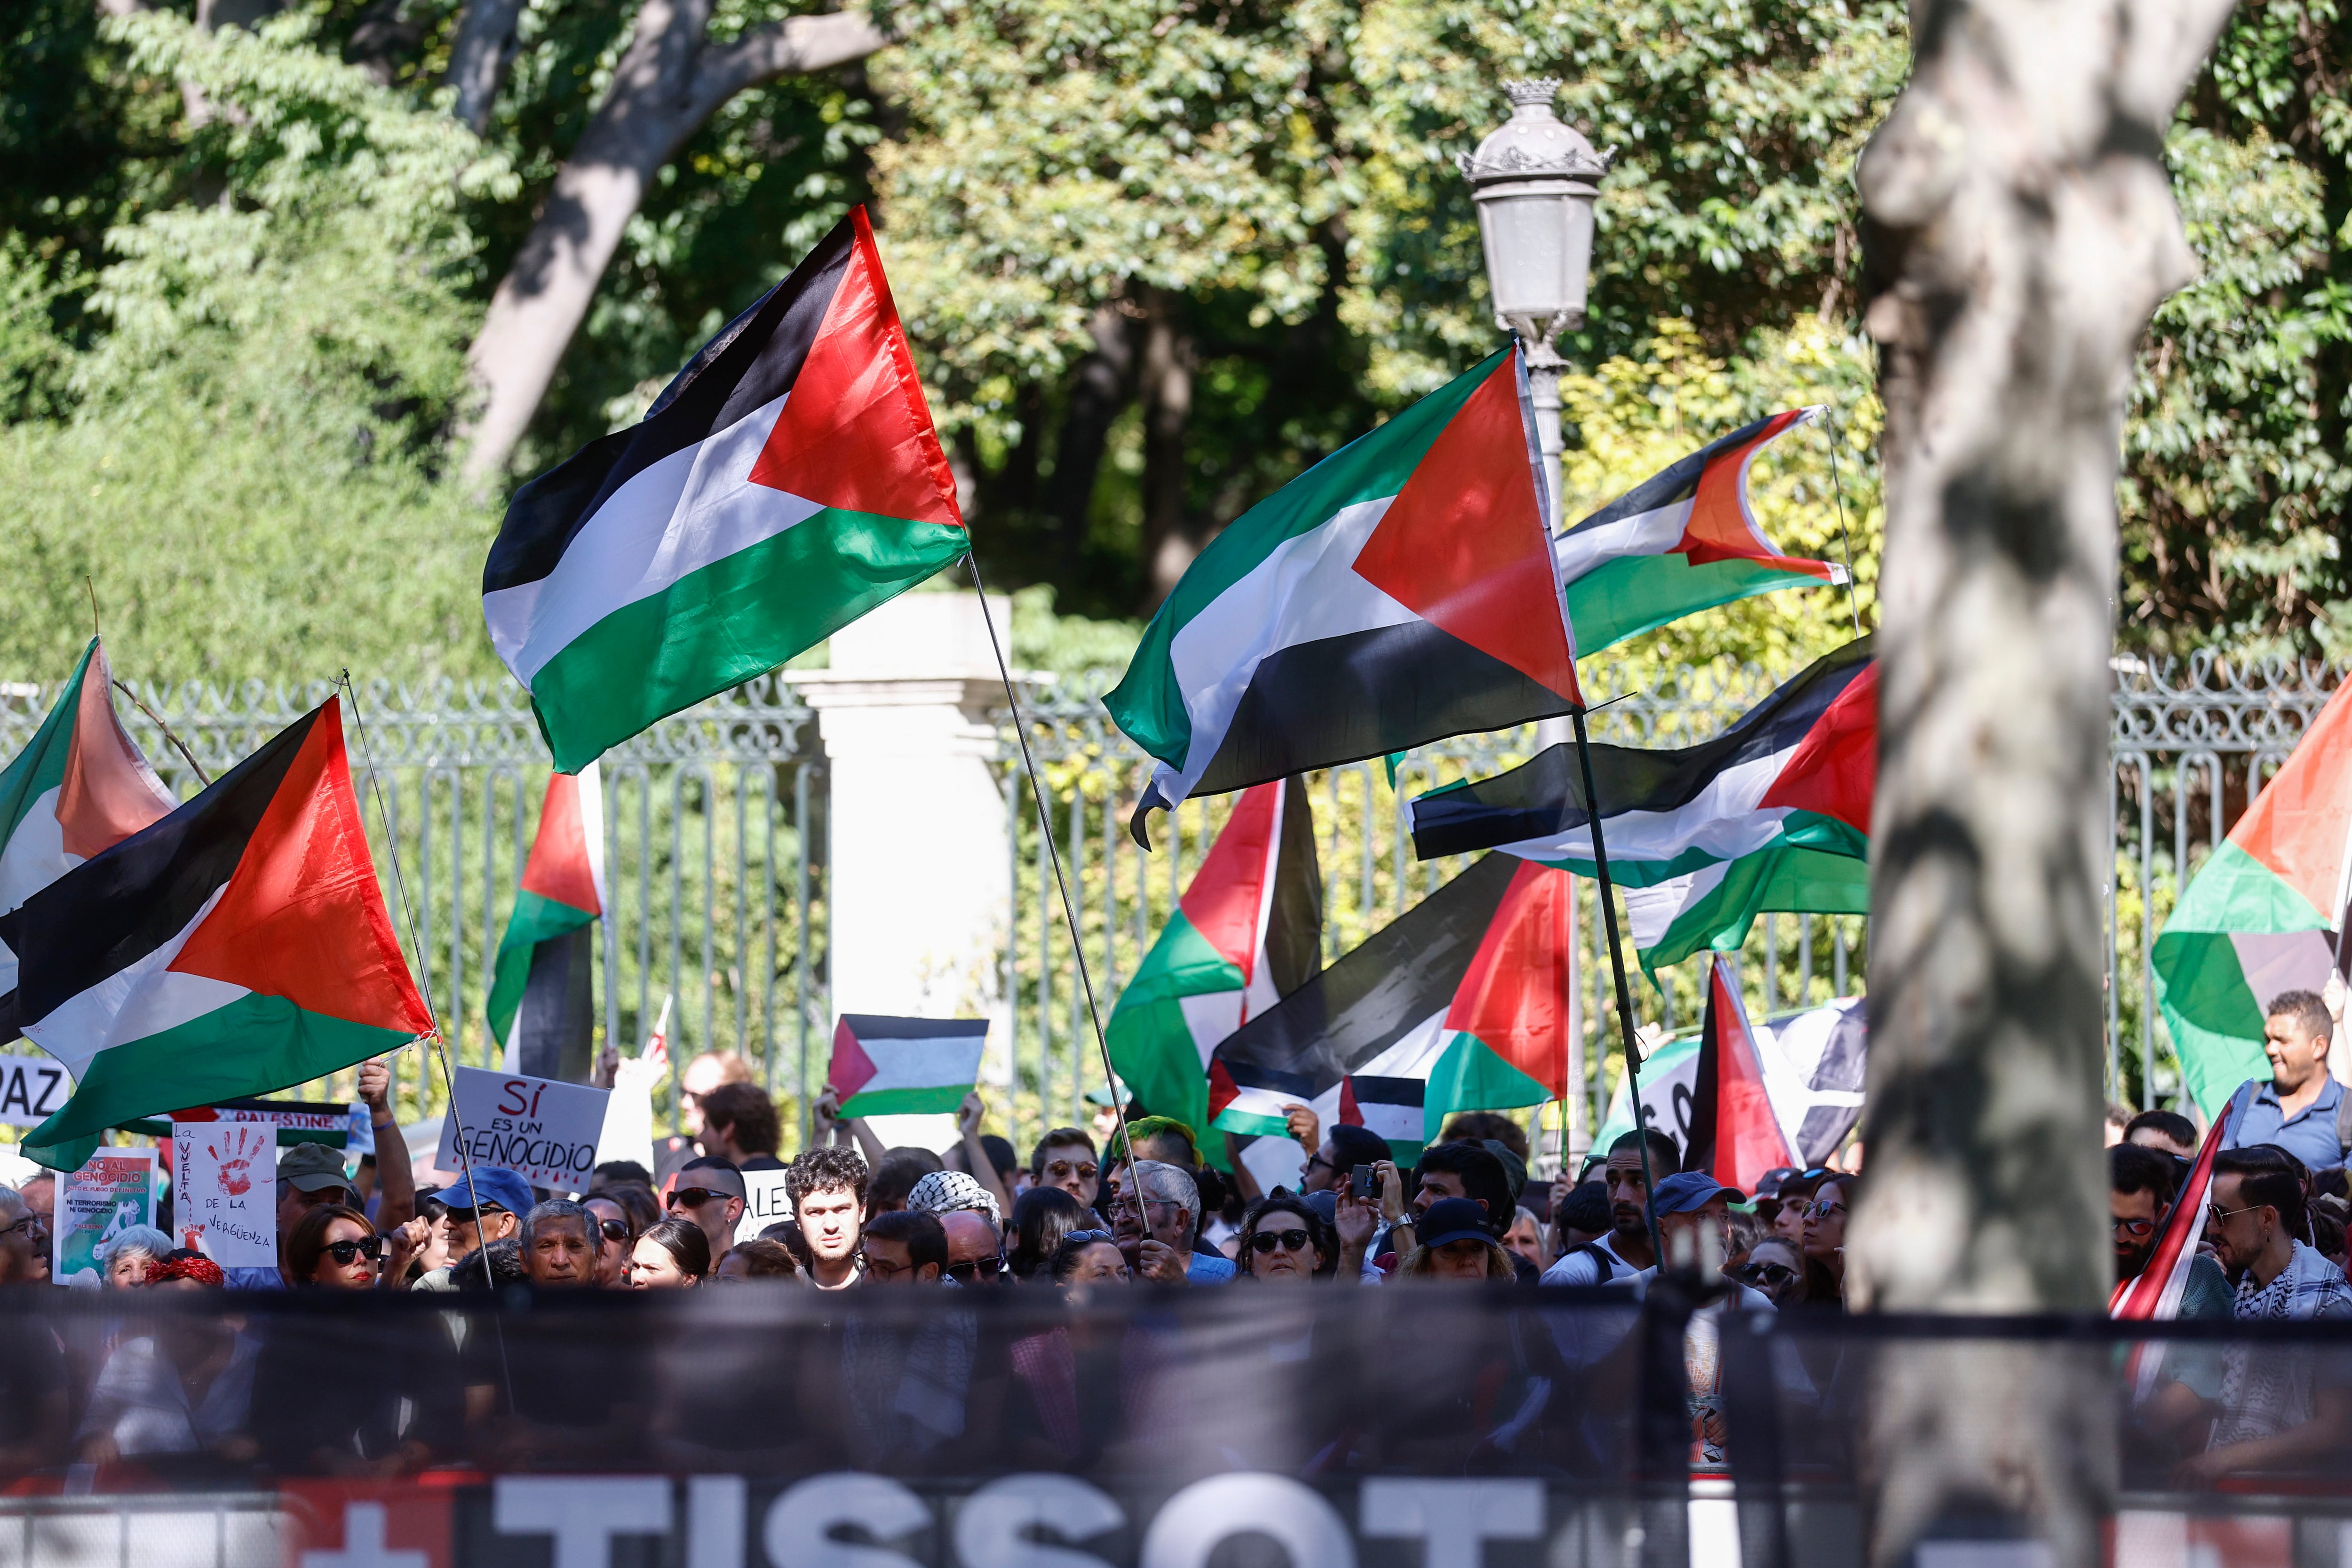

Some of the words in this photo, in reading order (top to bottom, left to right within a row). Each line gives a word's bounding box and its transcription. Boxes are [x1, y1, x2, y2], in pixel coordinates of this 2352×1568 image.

[0, 1066, 61, 1116] AZ
[498, 1081, 547, 1118] SÍ
[237, 1110, 334, 1129] PALESTINE
[492, 1118, 513, 1131] ES
[519, 1122, 542, 1135] UN
[73, 1171, 141, 1183] GENOCIDIO
[88, 1160, 106, 1170] NO
[110, 1161, 127, 1171] AL
[179, 1141, 192, 1201] VUELTA
[206, 1199, 219, 1209] DE
[230, 1199, 246, 1210] LA
[745, 1186, 794, 1219] LE
[209, 1214, 270, 1248] VERGÜENZA
[494, 1470, 1545, 1568] TISSOT
